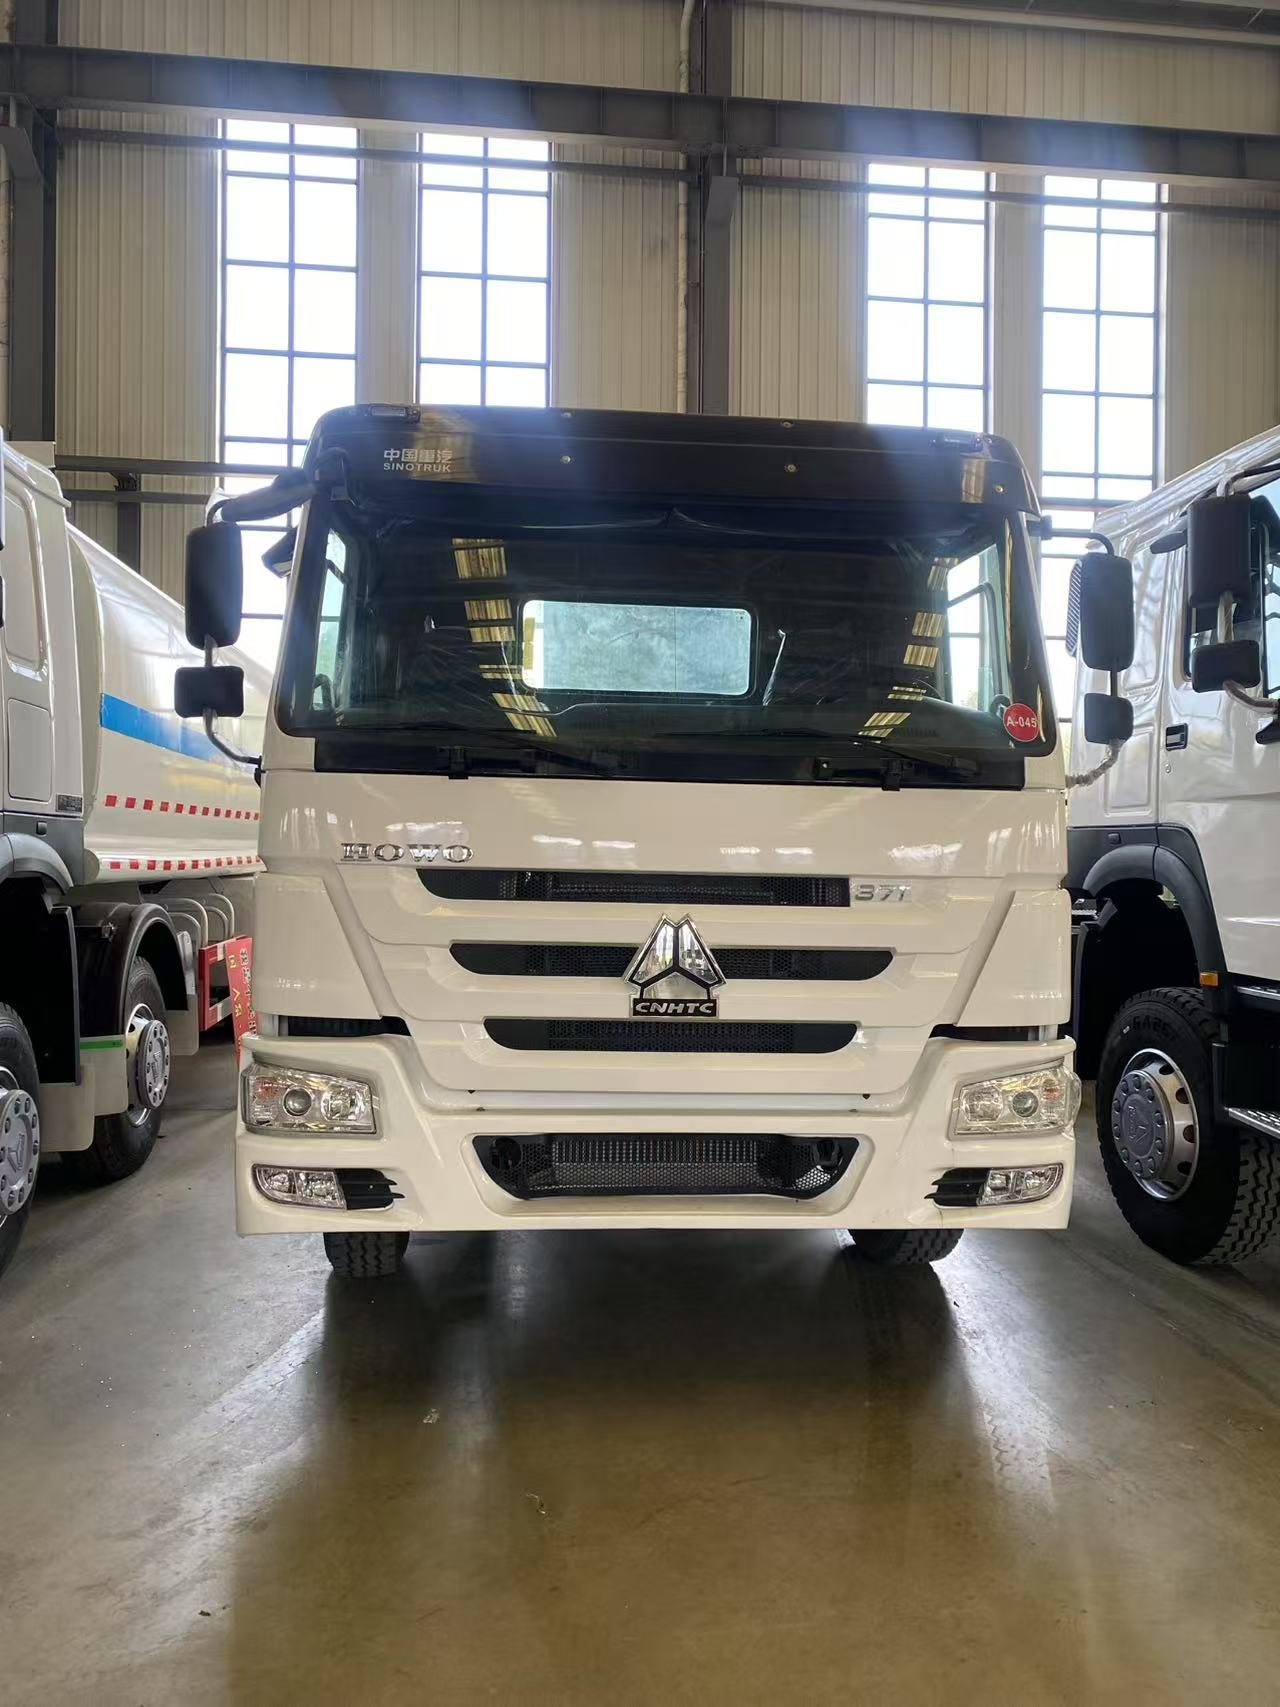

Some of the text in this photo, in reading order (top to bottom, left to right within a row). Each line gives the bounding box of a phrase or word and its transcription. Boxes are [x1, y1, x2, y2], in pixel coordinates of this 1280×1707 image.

[383, 462, 451, 473] SINOTRUK
[1006, 715, 1037, 728] A-045
[340, 842, 473, 863] HOWO
[635, 1002, 714, 1014] CNHTC
